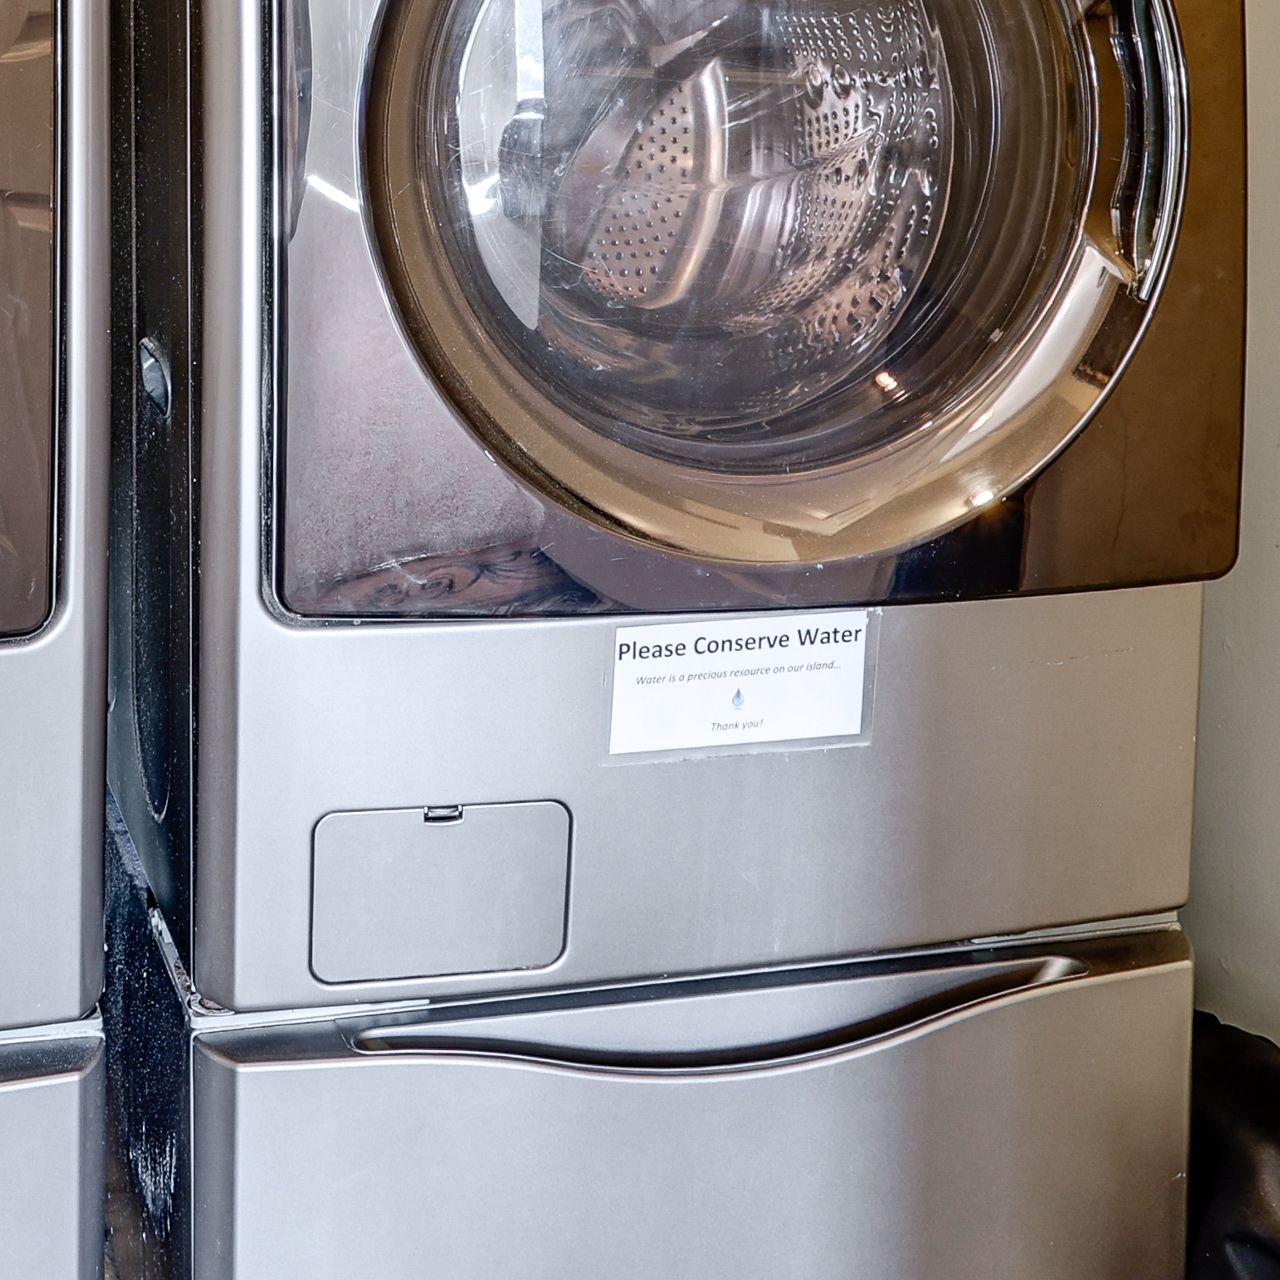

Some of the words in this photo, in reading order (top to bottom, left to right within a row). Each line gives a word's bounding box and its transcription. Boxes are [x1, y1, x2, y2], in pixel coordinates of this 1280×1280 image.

[618, 640, 687, 661] Please
[694, 632, 790, 655] Conserve
[797, 626, 862, 647] Water
[636, 675, 666, 686] Water
[668, 674, 676, 682] is
[686, 670, 727, 683] precious
[729, 666, 770, 678] resource
[773, 666, 785, 674] on
[788, 664, 803, 672] our
[806, 660, 842, 672] island...
[711, 720, 740, 732] Thank
[742, 718, 764, 730] you!
